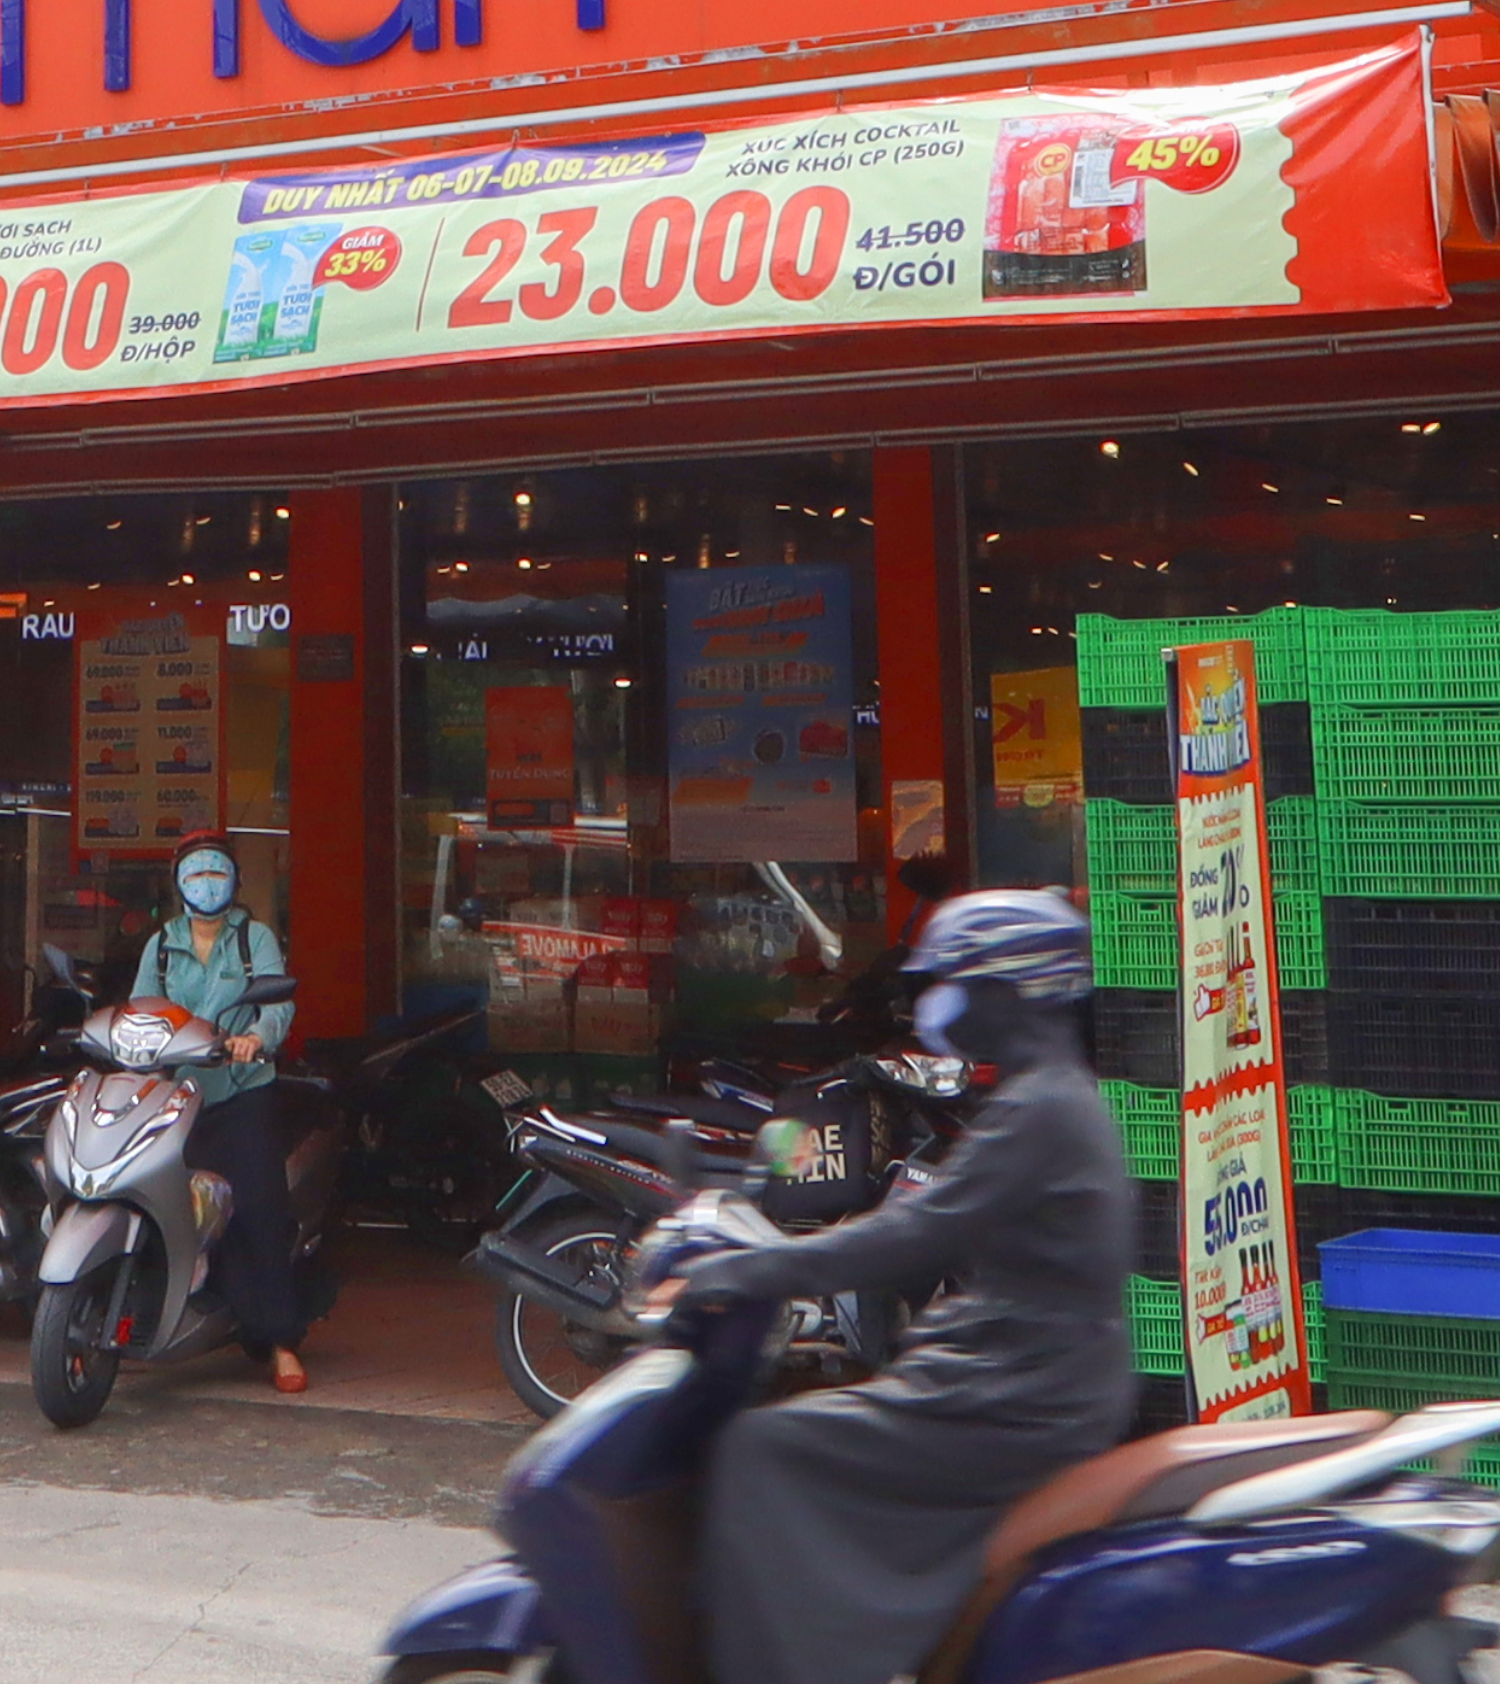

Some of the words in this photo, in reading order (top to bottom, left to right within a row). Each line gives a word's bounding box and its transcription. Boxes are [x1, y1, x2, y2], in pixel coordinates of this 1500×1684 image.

[741, 132, 788, 156] XÚC
[793, 126, 848, 153] XÍCH
[852, 118, 962, 147] COCKTAIL
[724, 150, 789, 180] XÔNG
[793, 146, 854, 176] KHÓI
[857, 146, 890, 170] CP
[892, 136, 965, 167] (250G)
[1042, 152, 1065, 166] CP
[1126, 135, 1220, 171] 45%
[262, 183, 324, 216] DUY
[328, 164, 402, 211] NHẤT
[405, 150, 668, 202] 06-07-08.09.2024
[22, 217, 72, 240] SẠCH
[342, 231, 384, 250] GIẢM
[854, 218, 965, 252] 41.500
[68, 235, 103, 259] (1L)
[447, 184, 851, 330] 23.000
[324, 249, 387, 278] 33%
[852, 250, 958, 291] Đ/GÓI
[128, 309, 202, 336] 39.000
[120, 337, 196, 363] Đ/HỘP
[22, 611, 75, 640] RAU
